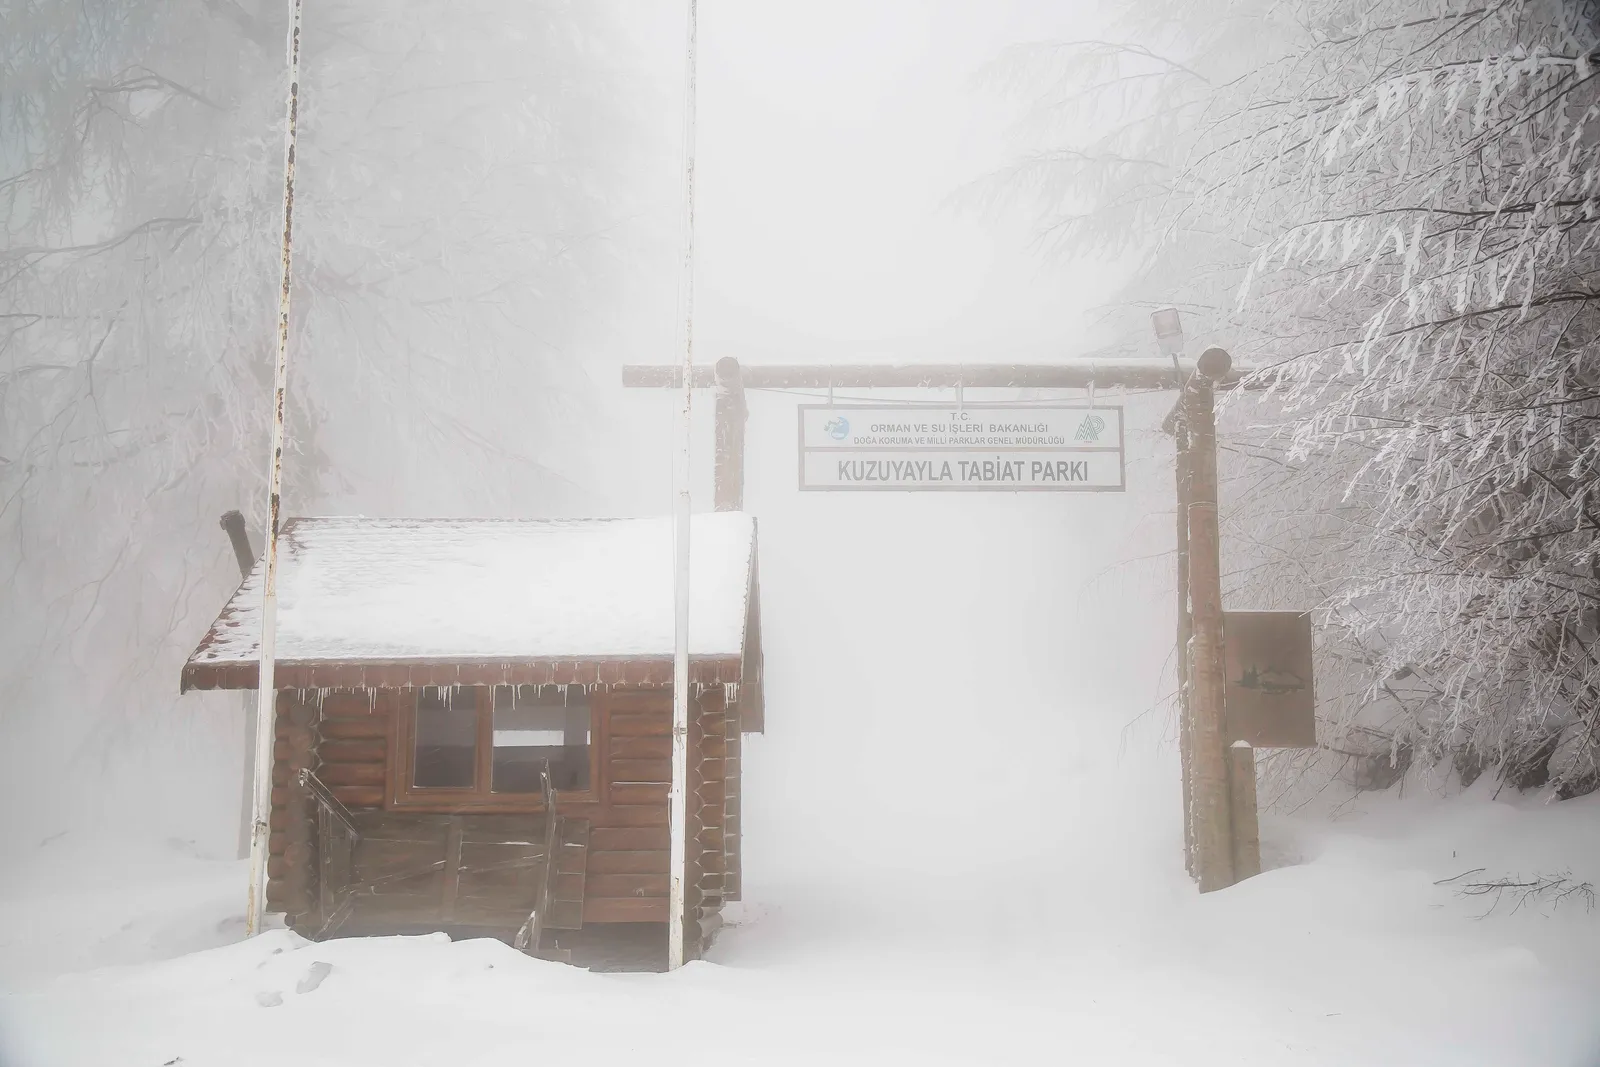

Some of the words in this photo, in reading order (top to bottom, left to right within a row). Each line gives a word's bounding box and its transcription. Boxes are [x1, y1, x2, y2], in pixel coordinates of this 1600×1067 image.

[870, 424, 911, 433] ORMAN
[913, 424, 928, 433] VE
[931, 424, 946, 433] SU
[989, 422, 1048, 433] BAKANLIĞI
[853, 436, 876, 445] DOĞA
[878, 436, 913, 445] KORUMA
[914, 436, 925, 445] VE
[948, 436, 986, 445] PARKLAR
[987, 436, 1014, 445] GENEL
[1015, 435, 1065, 445] MÜDÜRLÜĞÜ
[838, 460, 953, 481] KUZUYAYLA
[957, 456, 1025, 482] TABİAT
[1031, 460, 1088, 482] PARKI
